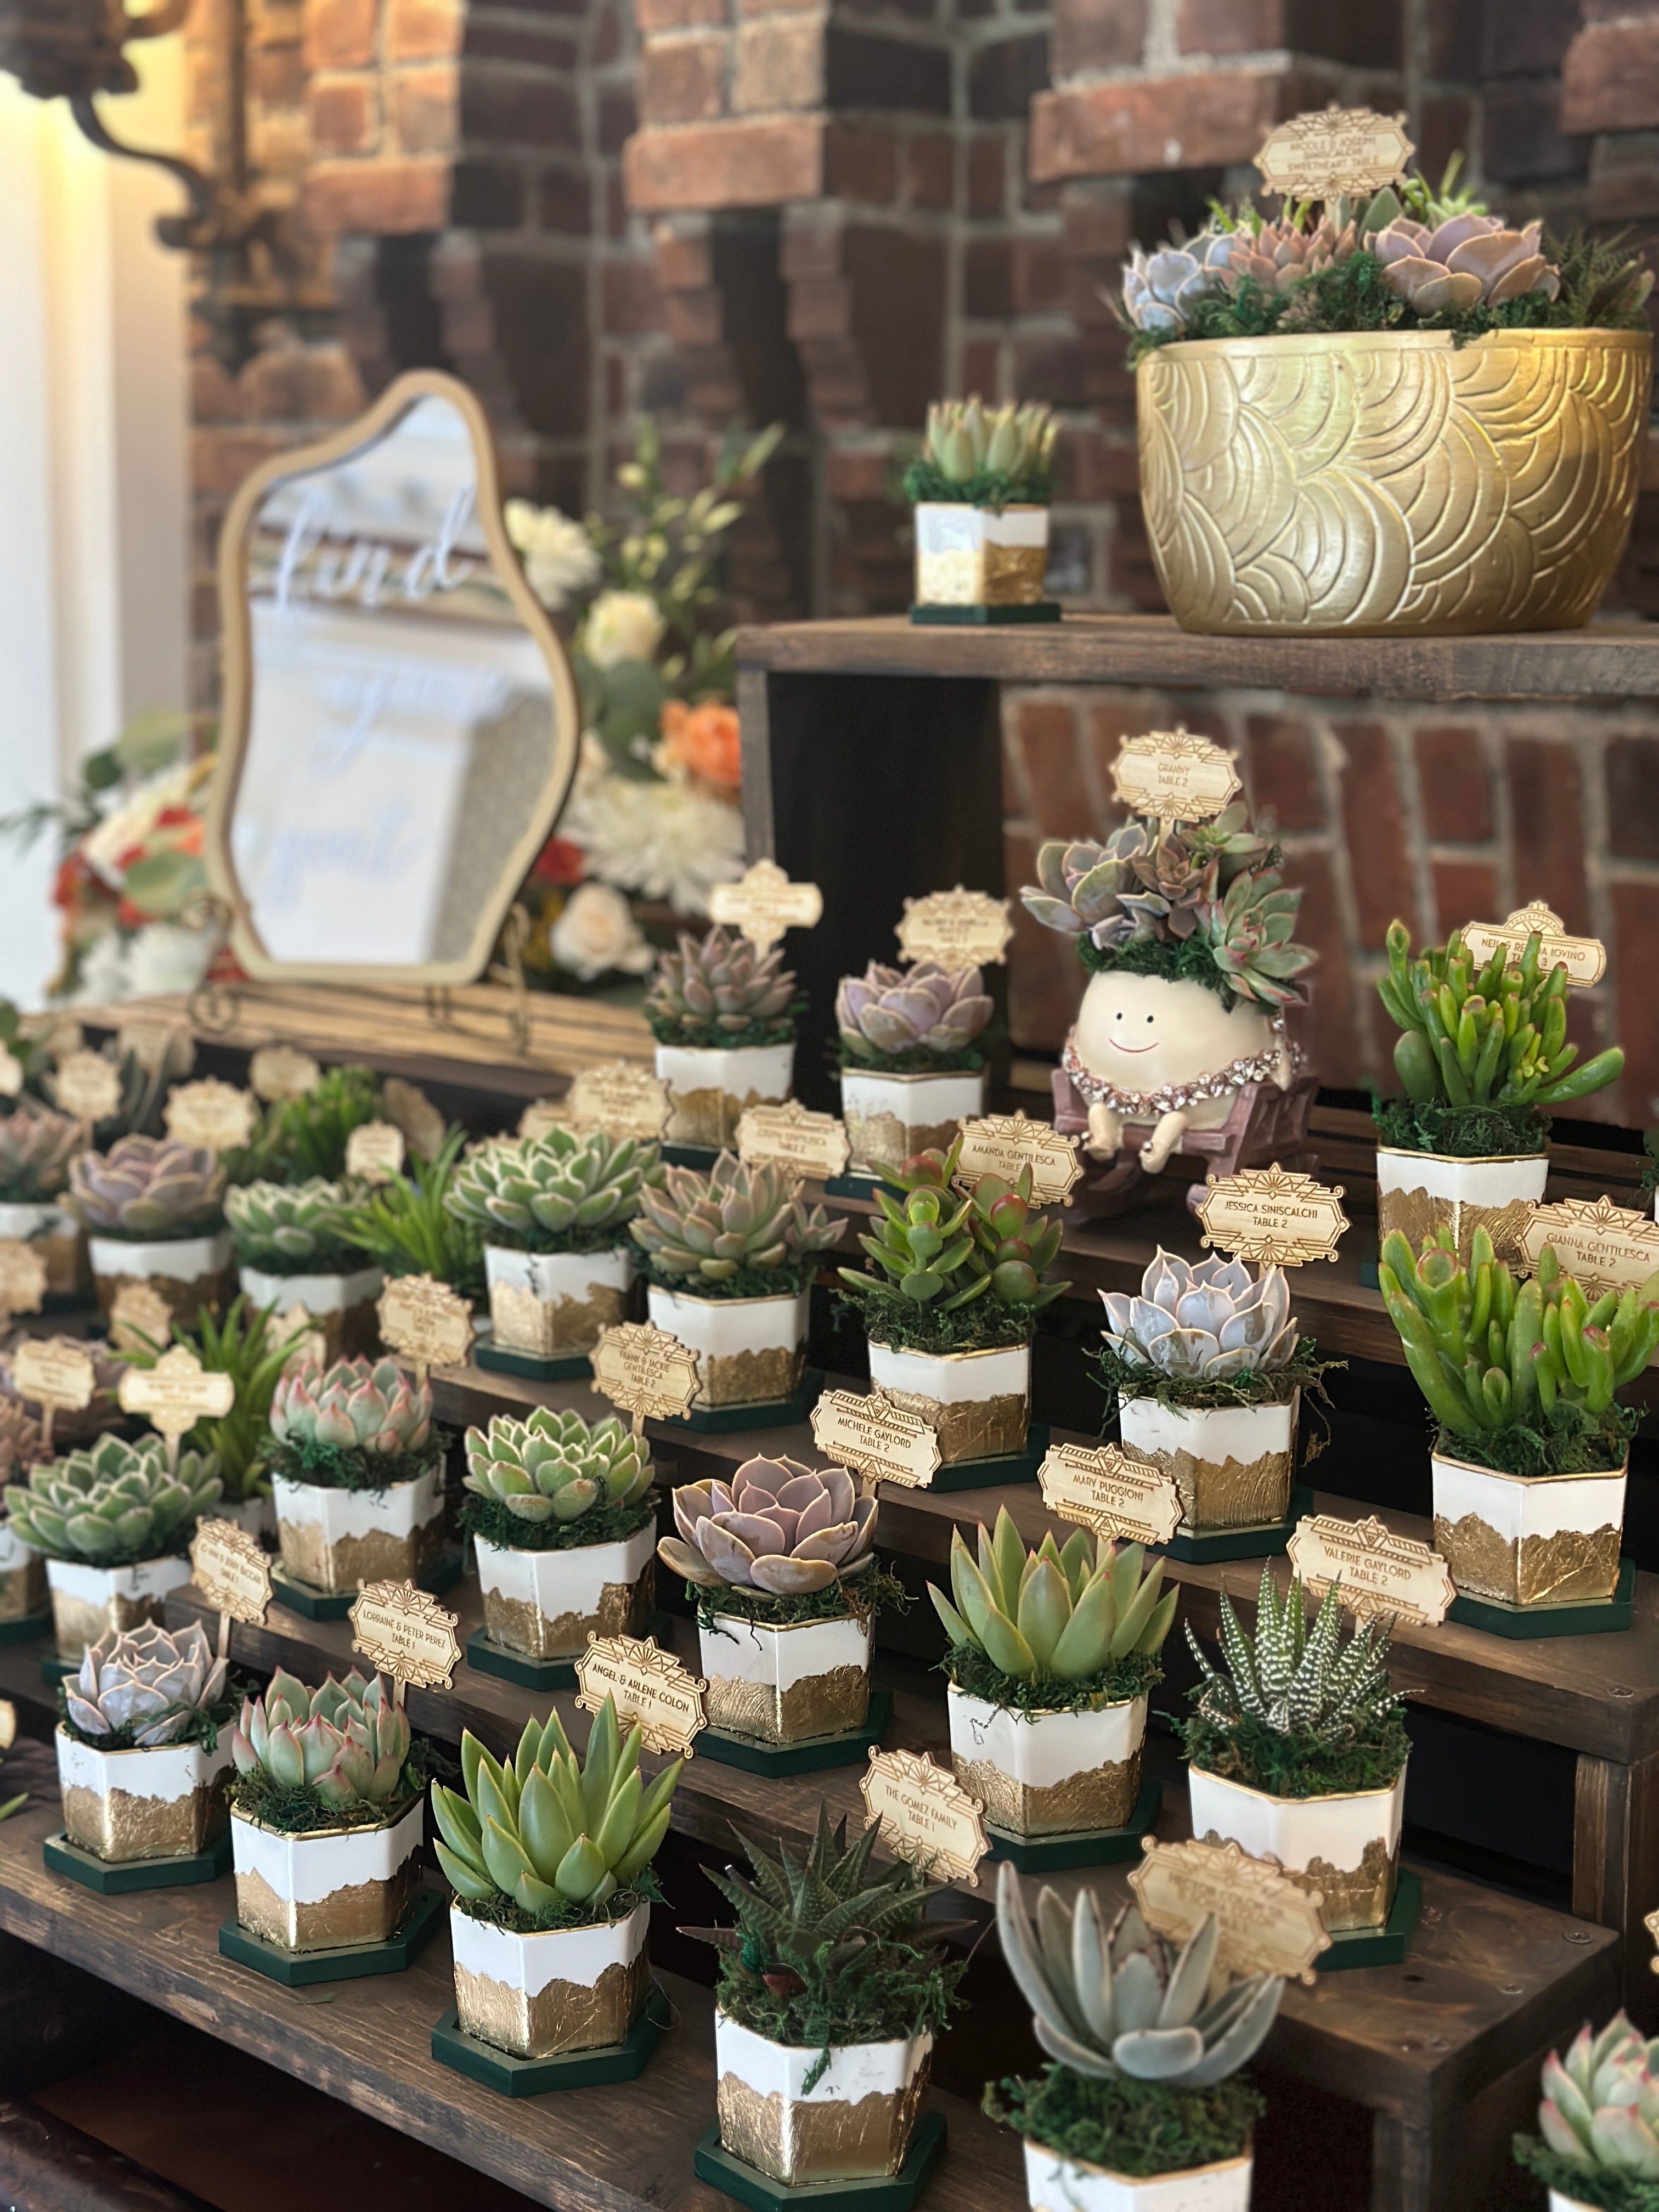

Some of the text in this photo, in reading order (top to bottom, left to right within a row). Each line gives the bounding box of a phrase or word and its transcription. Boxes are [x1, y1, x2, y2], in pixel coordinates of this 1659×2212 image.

[1352, 155, 1378, 165] TABLE
[270, 483, 475, 619] find
[1158, 763, 1190, 775] GRANNY
[1158, 776, 1188, 787] TABLE 2
[1514, 943, 1547, 956] REA
[1551, 949, 1586, 961] IOVINO
[1540, 957, 1547, 966] 3
[972, 1145, 1055, 1166] AMANDA GENTILESCA
[998, 1161, 1020, 1172] TABLE
[1225, 1201, 1318, 1218] JESSICA SINISCALCHI
[1253, 1216, 1288, 1228] TABLE 2
[1547, 1233, 1650, 1262] GIANNA GENTILESCA
[1576, 1251, 1616, 1267] TABLE 2
[619, 1351, 640, 1363] FRANK
[649, 1359, 671, 1372] JACKIE
[624, 1362, 663, 1380] GENTILESCA
[631, 1373, 656, 1388] TABLE 2
[838, 1417, 911, 1448] MICHELE GAYLORD
[860, 1435, 890, 1452] TABLE 2
[1073, 1475, 1143, 1502] MARY PUGGIONI
[1091, 1490, 1125, 1508] TABLE 2
[1324, 1546, 1412, 1581] VALERIE GAYLORD
[221, 1568, 235, 1582] TABLE
[1350, 1566, 1388, 1586] TABLE 2
[363, 1610, 446, 1649] LORRAINE & PETER PEREZ
[392, 1633, 411, 1647] TABLE
[592, 1663, 690, 1713] ANGEL & ARLENE COLON
[624, 1690, 652, 1709] TABLE 1
[885, 1785, 957, 1830] THE GOMEZ FAMILY
[908, 1810, 935, 1832] TABLE 1
